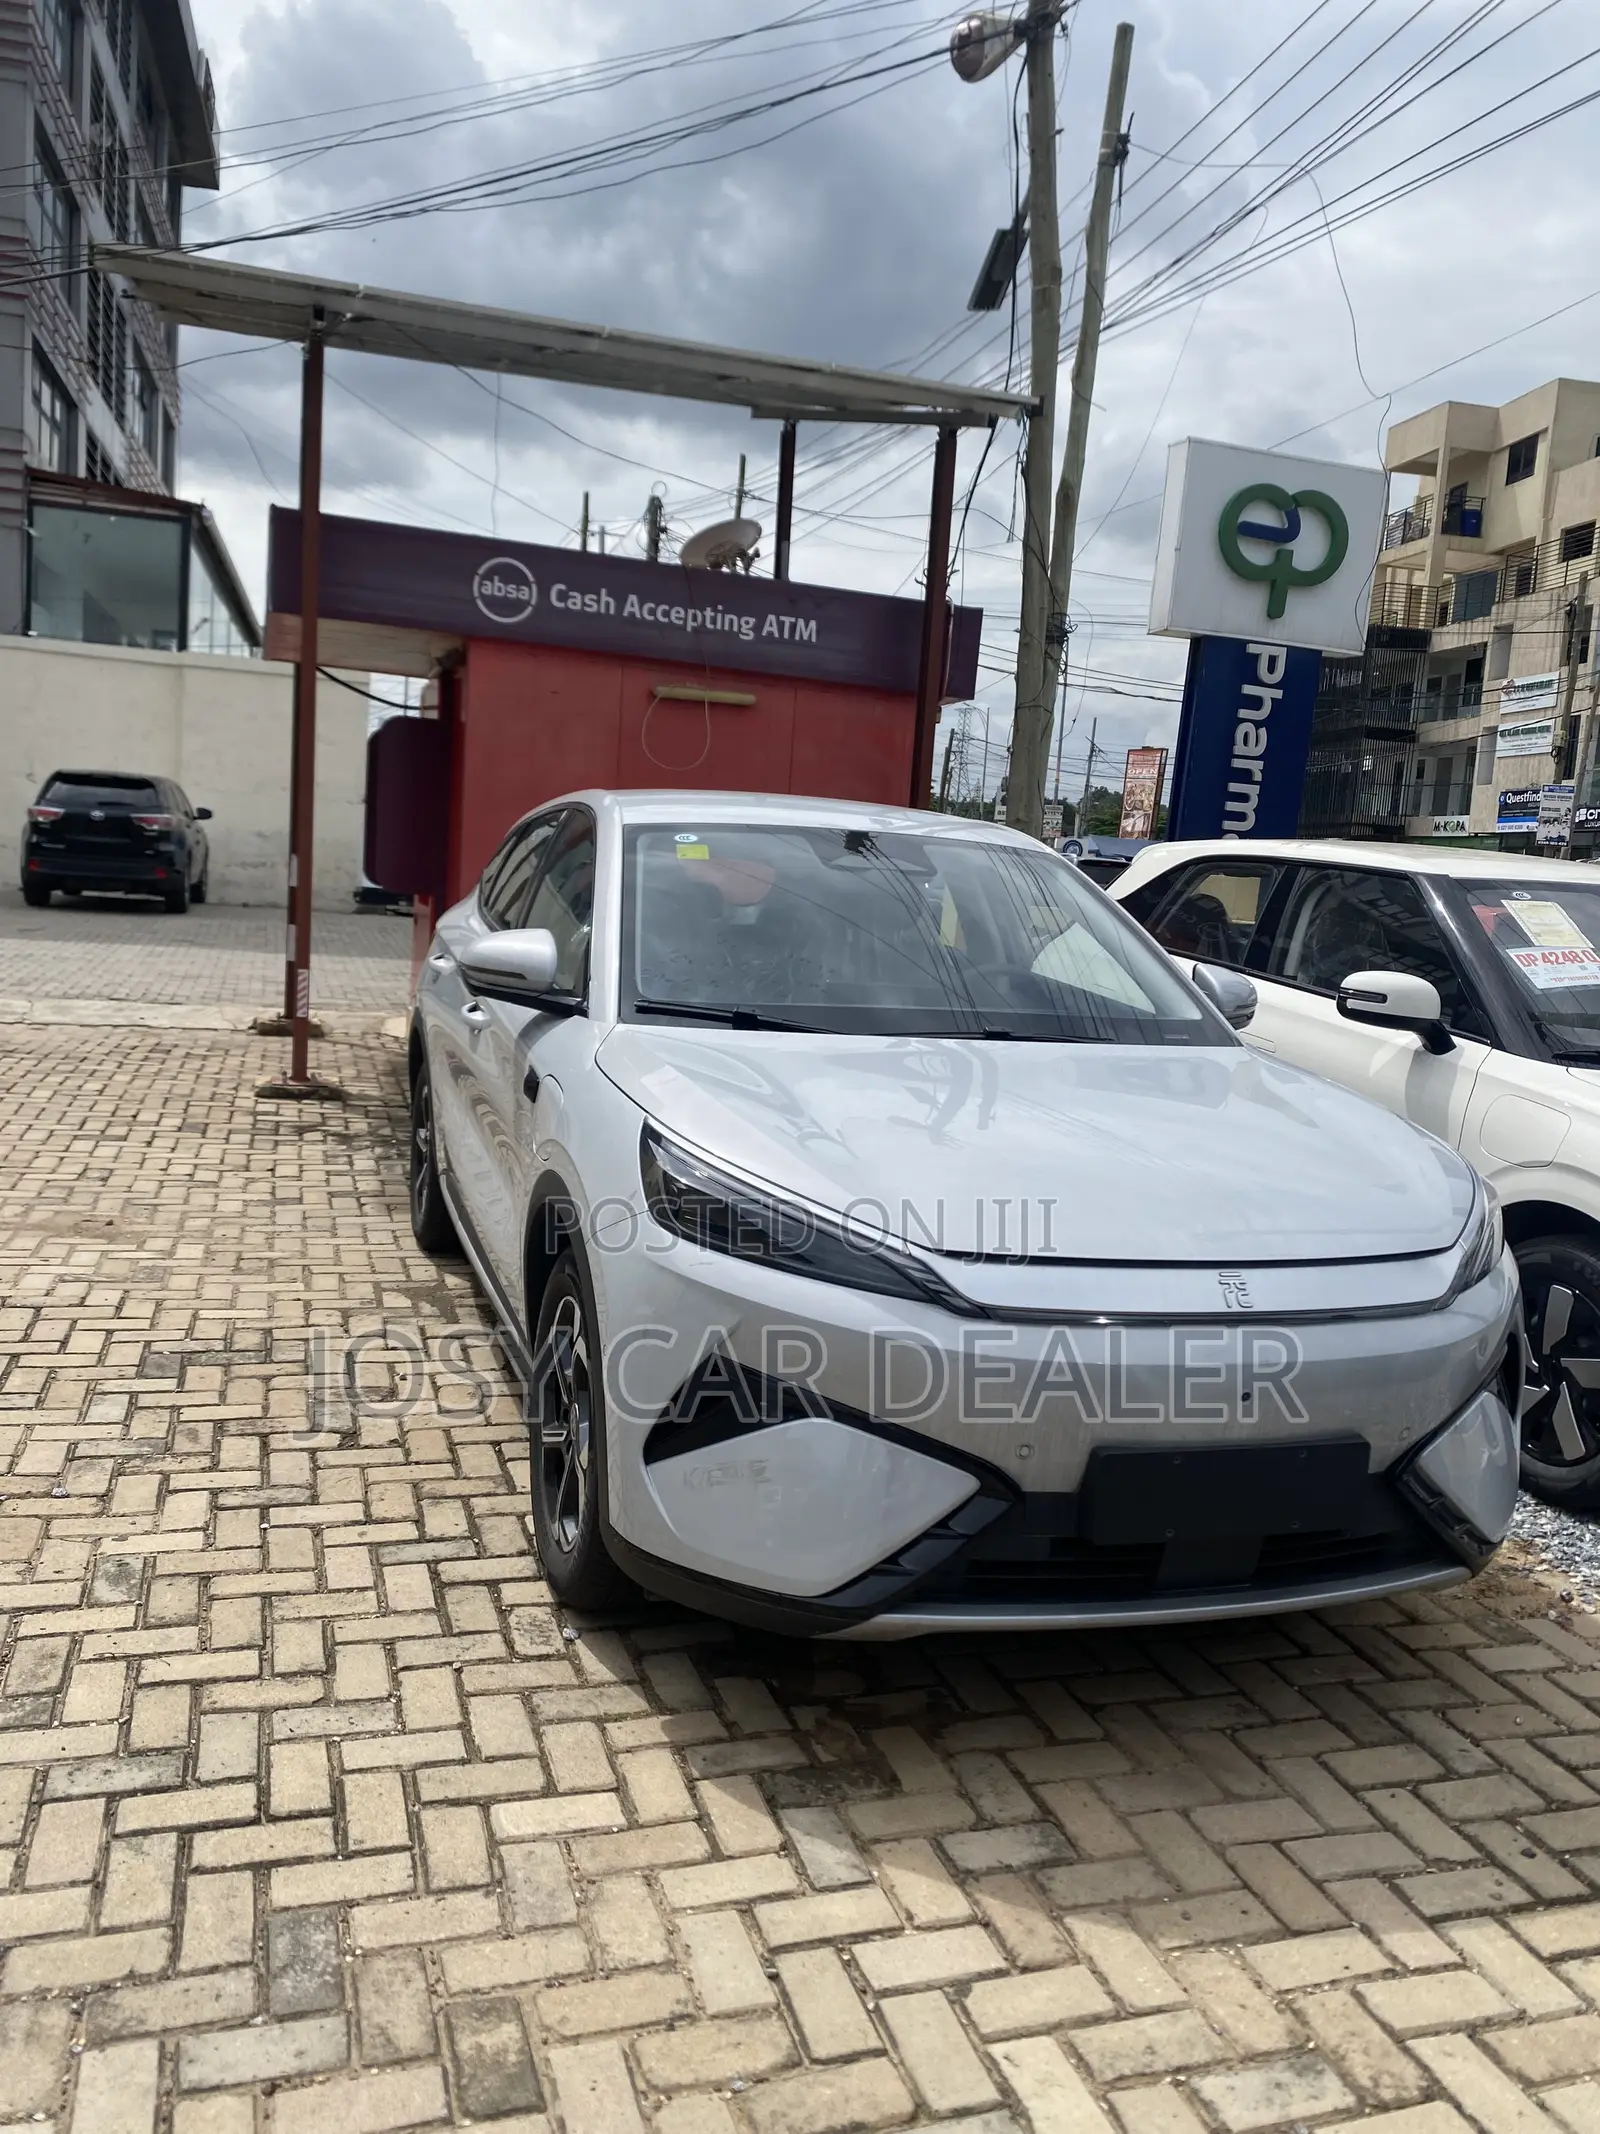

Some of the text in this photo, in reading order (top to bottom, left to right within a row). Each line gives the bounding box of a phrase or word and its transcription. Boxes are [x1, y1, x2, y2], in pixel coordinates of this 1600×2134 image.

[480, 575, 529, 600] absa
[550, 583, 817, 642] Cash Accepting ATM
[1514, 953, 1539, 967] DP
[1541, 950, 1585, 965] 4248
